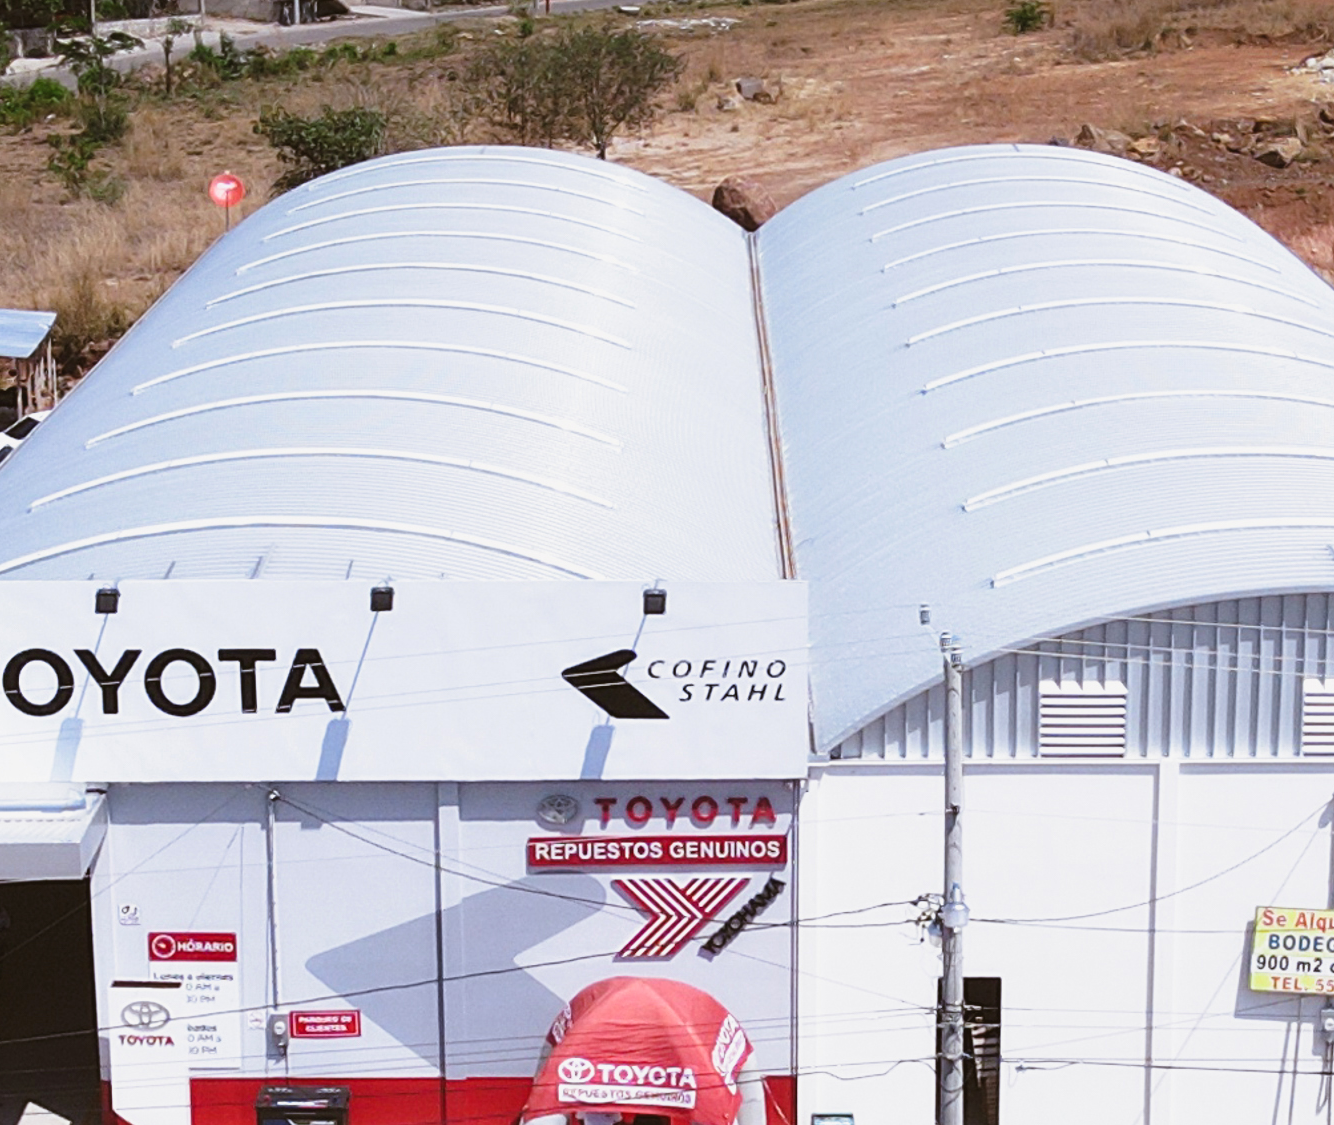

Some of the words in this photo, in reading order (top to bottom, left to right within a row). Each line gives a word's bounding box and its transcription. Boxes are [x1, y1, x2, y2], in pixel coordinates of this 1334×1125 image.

[647, 659, 787, 679] COFINO
[679, 682, 787, 701] STAHL
[594, 795, 777, 823] TOYOTA
[535, 841, 663, 860] REPUESTOS
[669, 840, 781, 859] GENUINOS
[701, 877, 786, 955] YOKOHAMA
[1262, 909, 1288, 927] Se
[1256, 954, 1290, 971] 900
[1296, 957, 1323, 973] m2
[1271, 976, 1309, 991] TEL.
[118, 1034, 175, 1046] TOYOTA
[597, 1064, 697, 1088] TOYOTA
